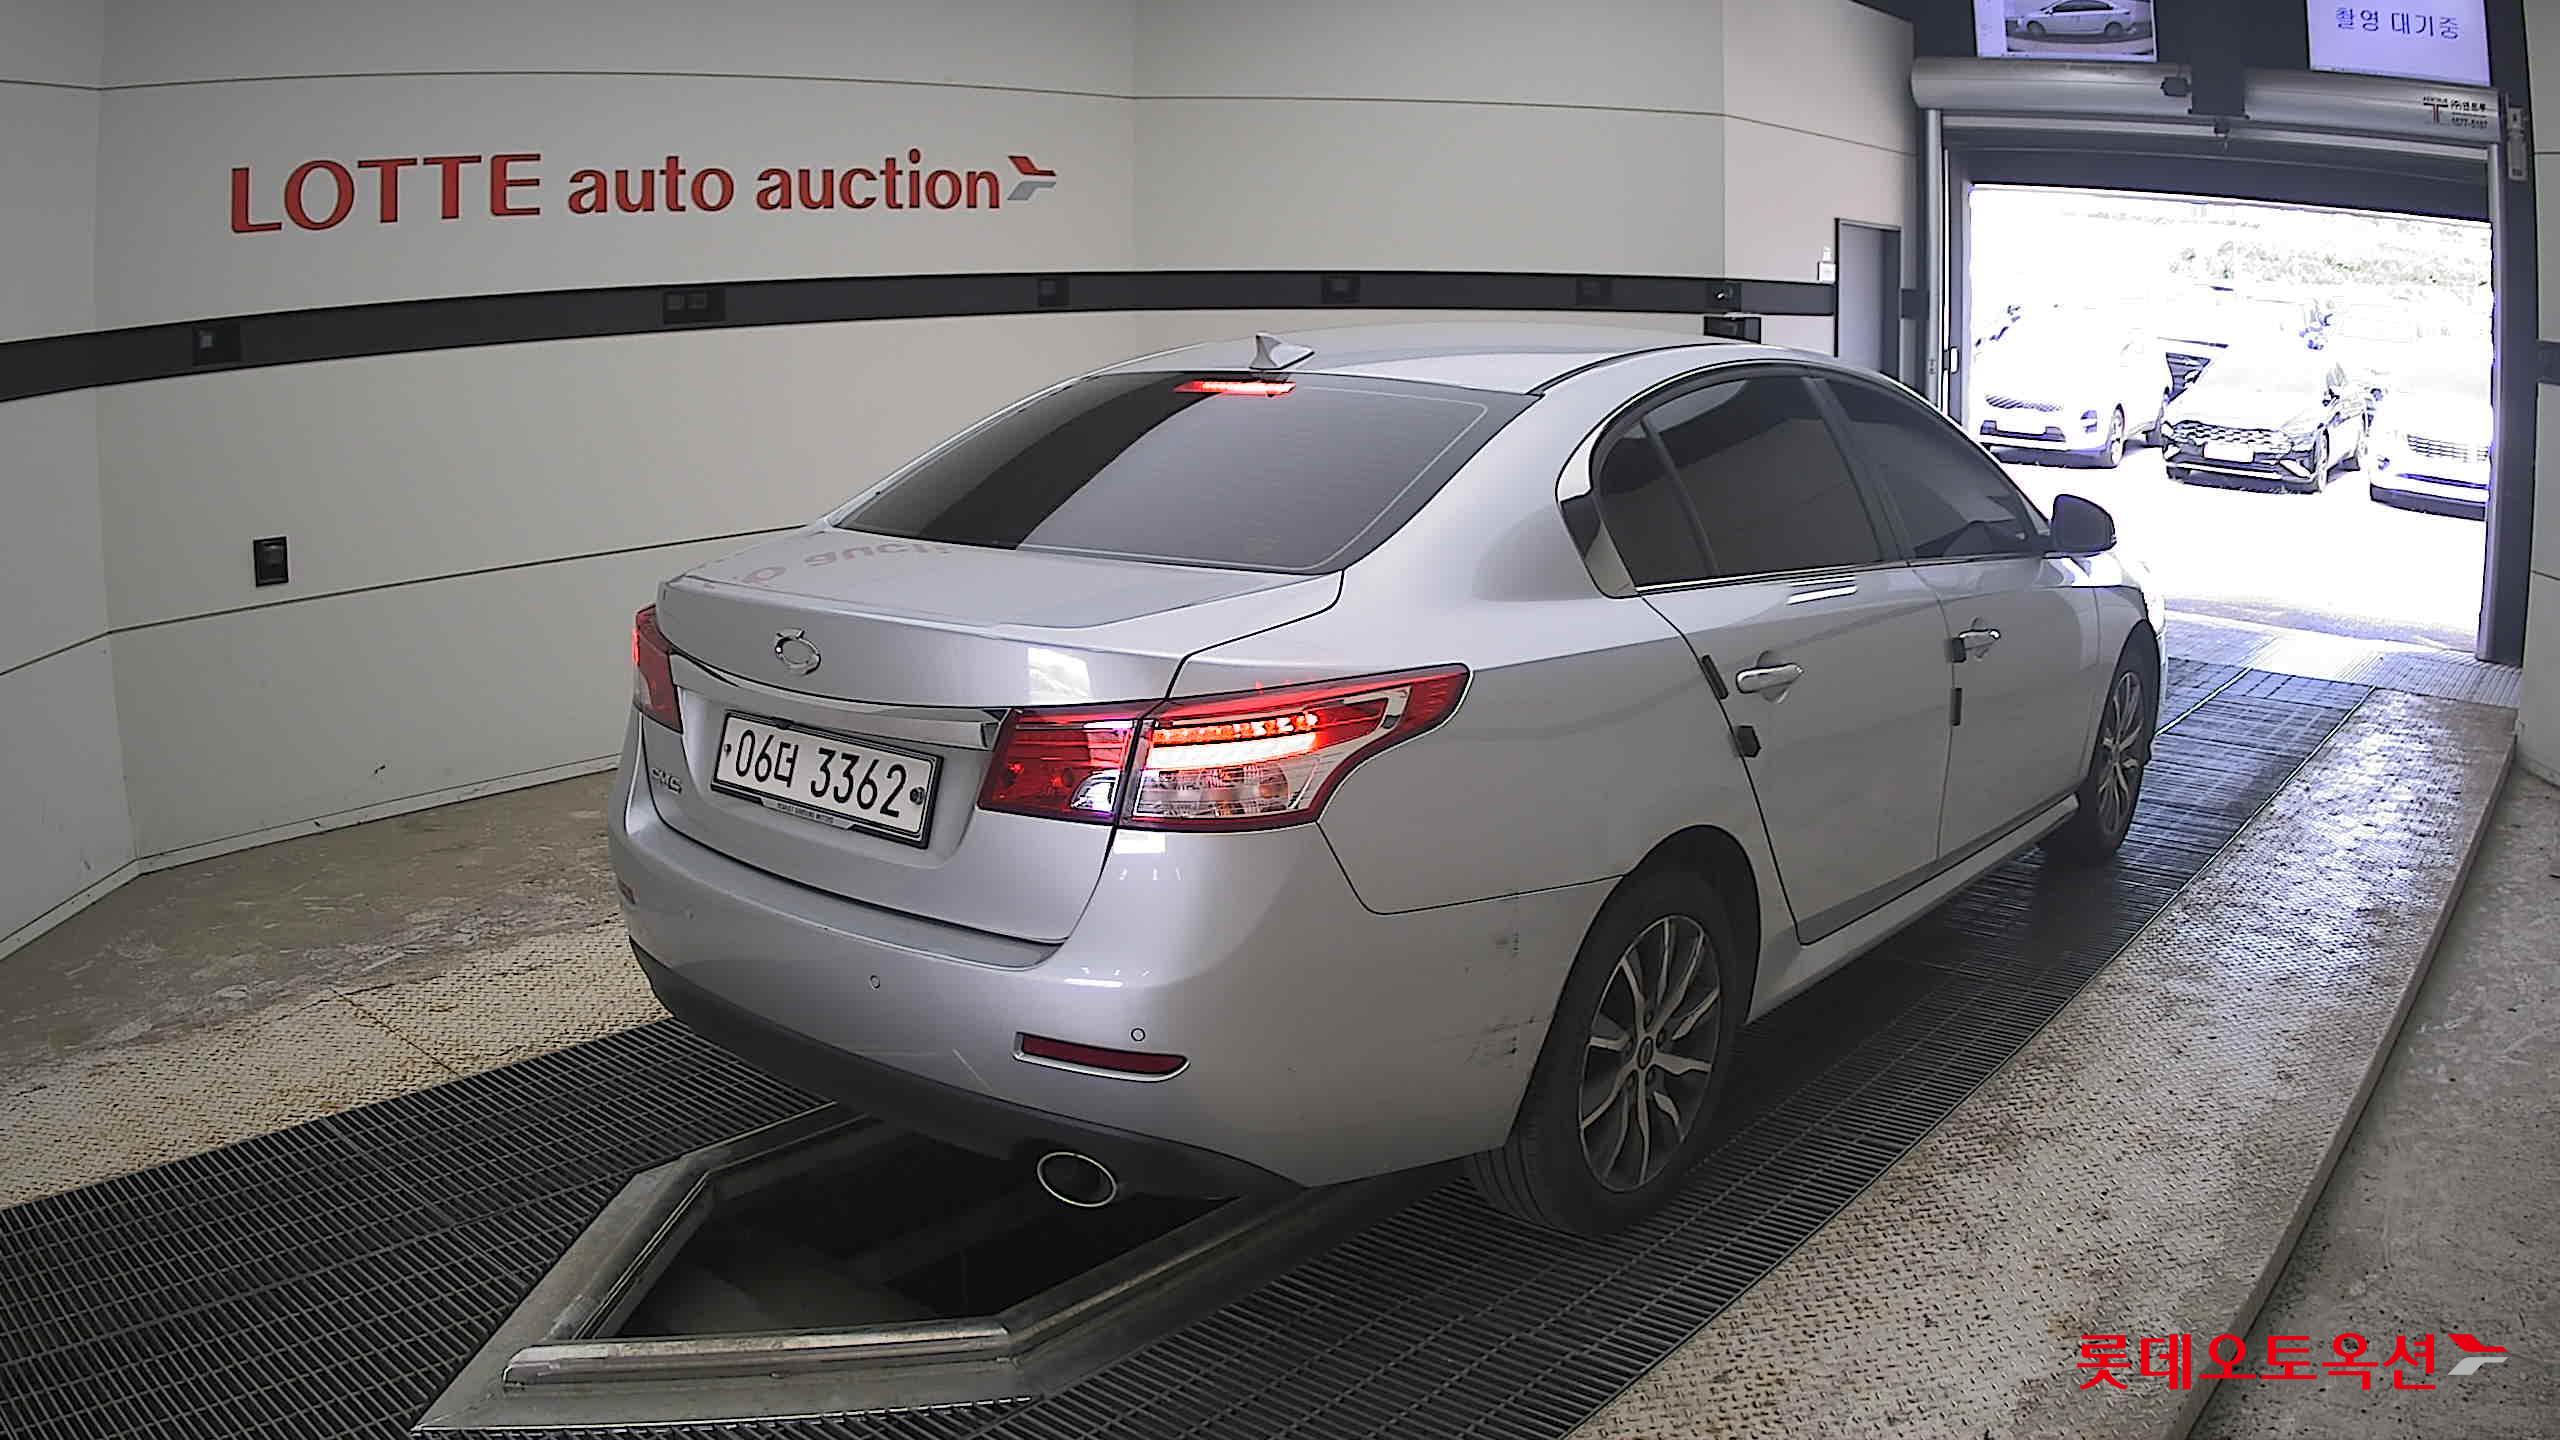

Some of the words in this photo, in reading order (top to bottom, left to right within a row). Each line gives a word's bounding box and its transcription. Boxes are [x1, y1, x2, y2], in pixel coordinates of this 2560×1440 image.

[2391, 12, 2459, 40] 대기중
[231, 154, 542, 234] LOTTE
[568, 156, 734, 215] auto
[757, 149, 1001, 211] auction
[735, 729, 799, 788] 06더
[810, 747, 907, 817] 3362
